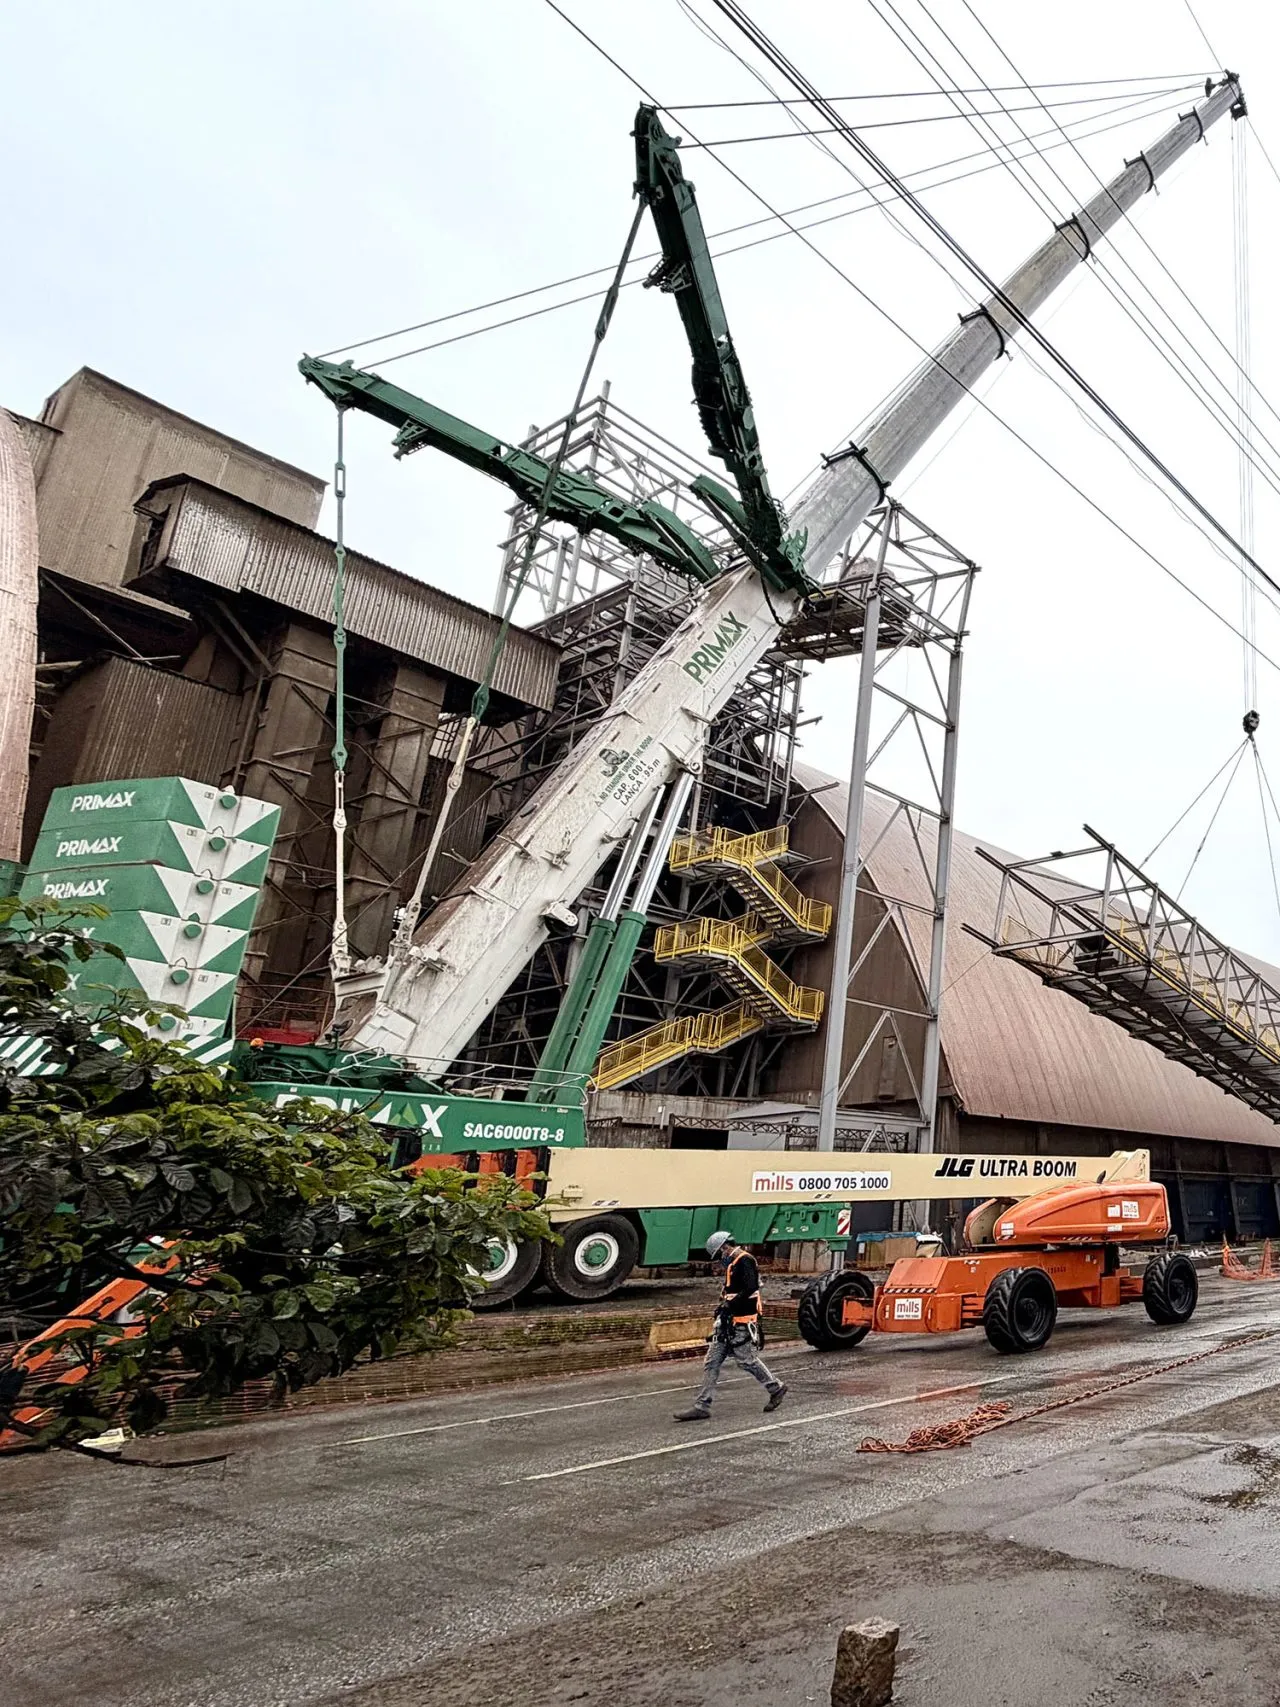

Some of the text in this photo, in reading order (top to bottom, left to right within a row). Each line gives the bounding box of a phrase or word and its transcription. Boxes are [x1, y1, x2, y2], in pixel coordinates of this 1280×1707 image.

[683, 611, 748, 685] PRIMAX
[599, 791, 608, 801] NO
[605, 770, 625, 794] STANDING
[621, 756, 636, 773] UNDER
[614, 782, 630, 800] CAP.
[628, 764, 643, 781] 600
[70, 791, 136, 812] PRIMAX
[620, 780, 643, 806] LANÇA
[56, 836, 123, 857] PRIMAX
[43, 878, 109, 899] PRIMAX
[463, 1122, 564, 1142] SAC6000T8-8
[934, 1158, 1077, 1177] JLG ULTRA BOOM
[754, 1172, 889, 1191] mills 0800 705 1000
[896, 1299, 919, 1313] mills
